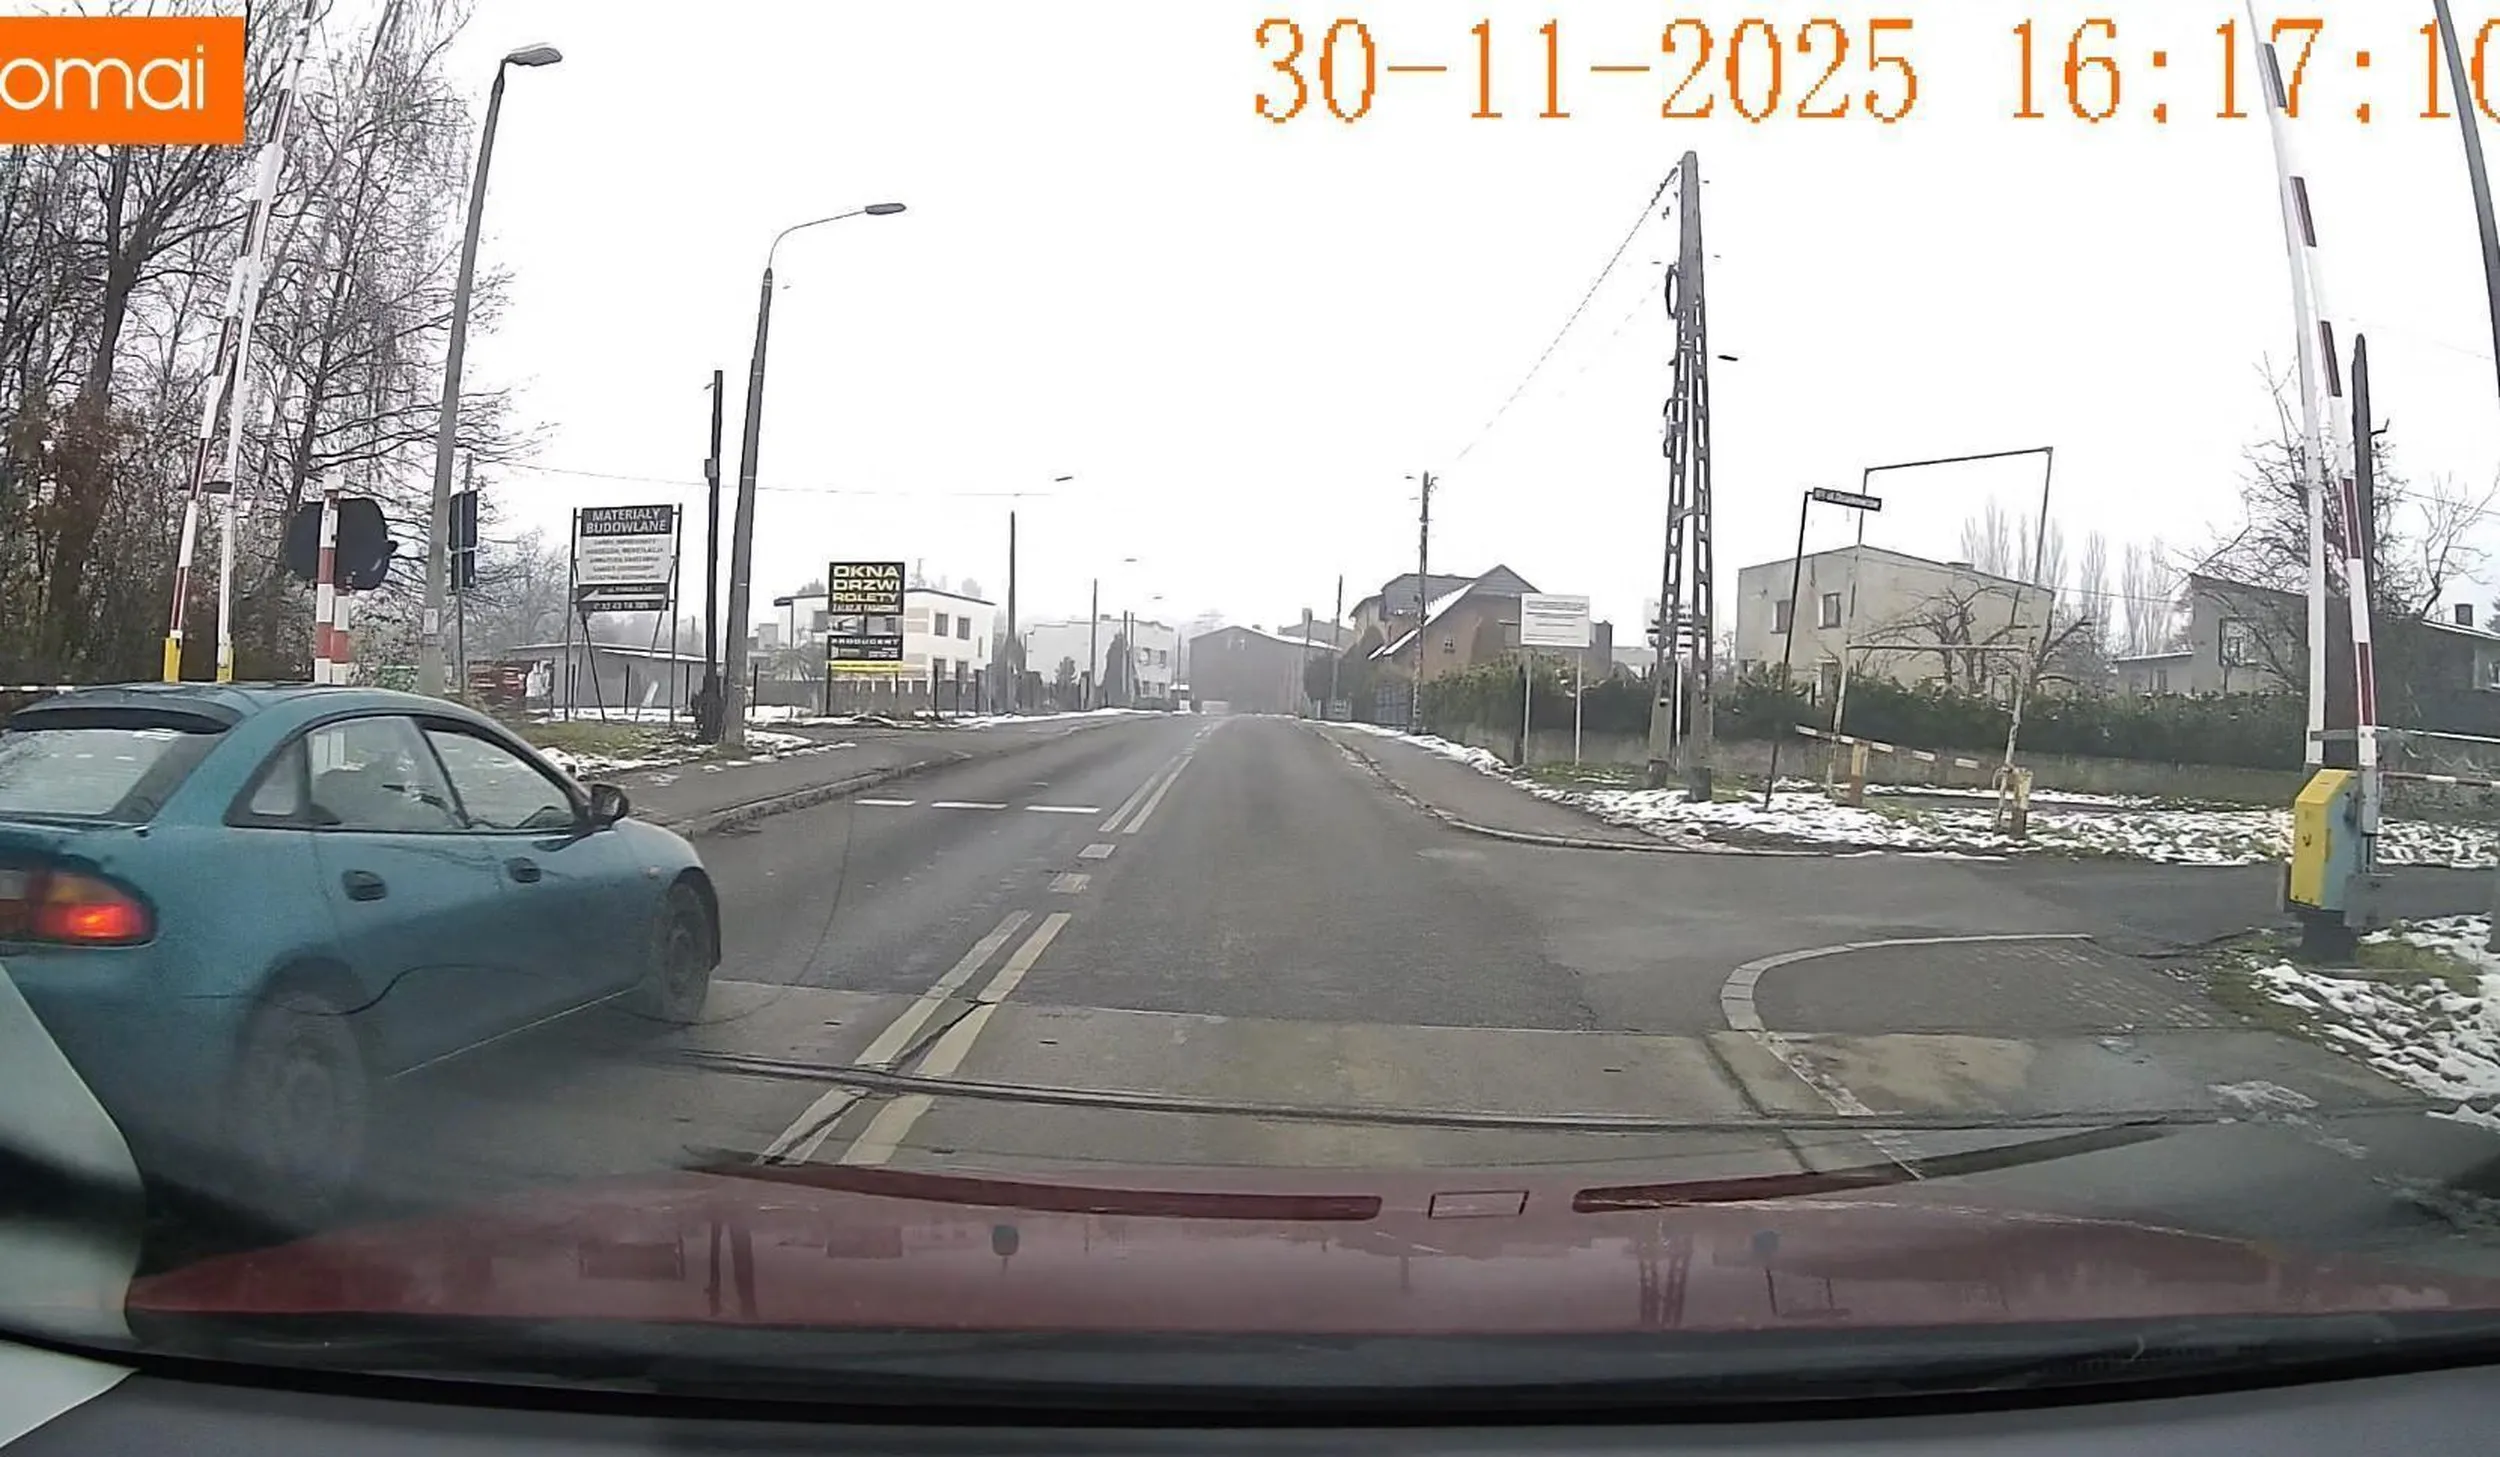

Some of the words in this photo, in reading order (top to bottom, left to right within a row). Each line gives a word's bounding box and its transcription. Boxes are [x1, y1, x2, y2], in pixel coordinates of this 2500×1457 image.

[586, 520, 667, 534] BUDOWLANE
[833, 565, 900, 578] OKNA
[833, 579, 900, 591] DRZWI
[832, 592, 898, 603] ROLETY
